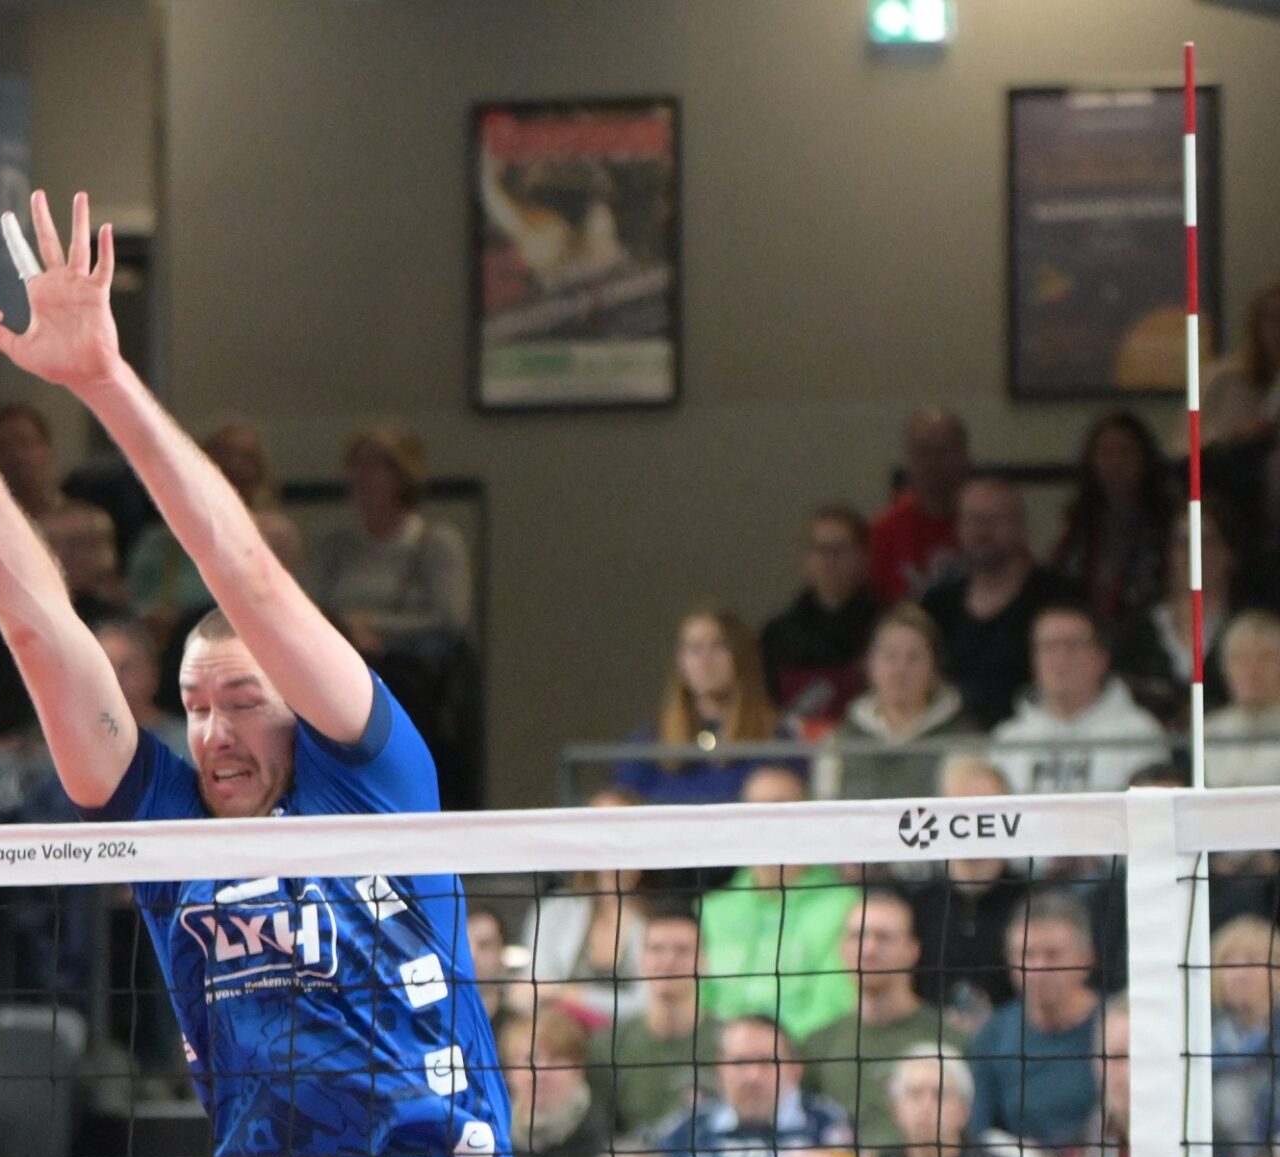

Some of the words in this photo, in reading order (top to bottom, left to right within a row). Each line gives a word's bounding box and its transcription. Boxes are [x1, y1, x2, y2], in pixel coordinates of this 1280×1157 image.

[949, 812, 1022, 839] CEV
[41, 842, 92, 862] Volley
[97, 841, 137, 858] 2024
